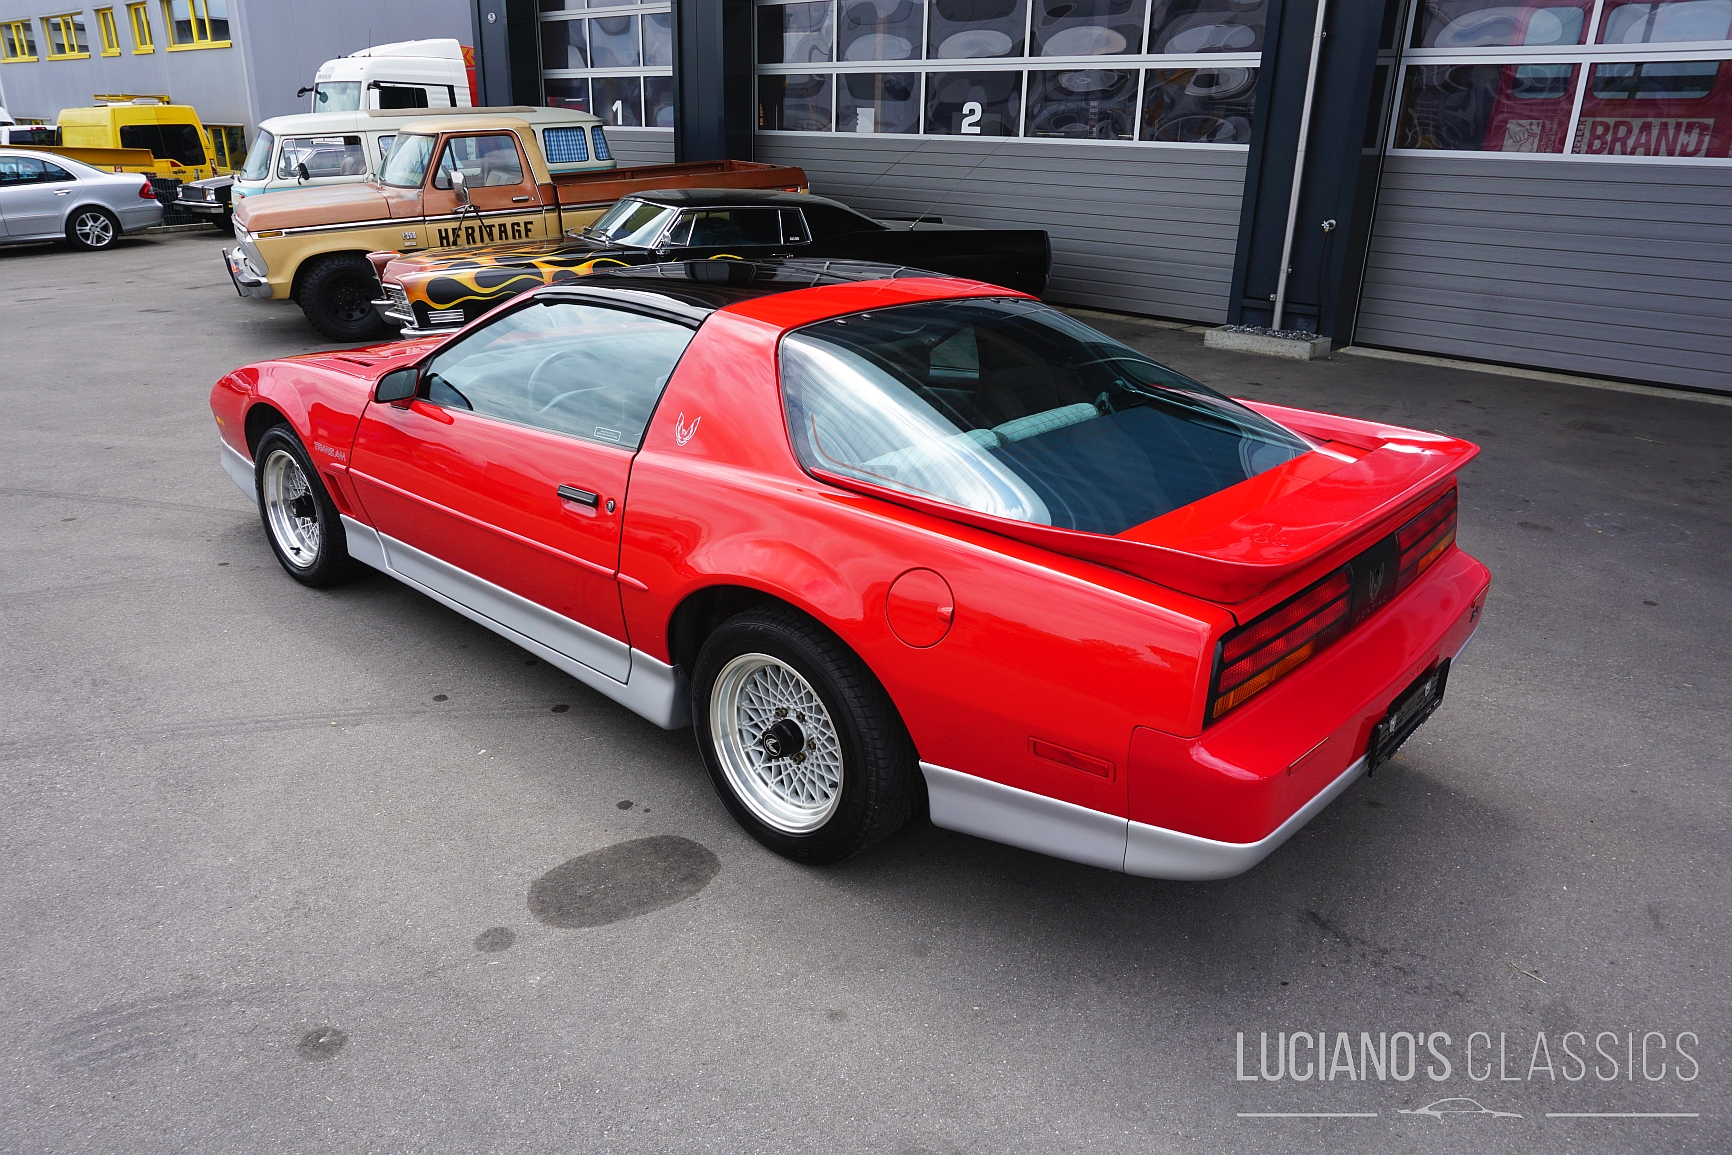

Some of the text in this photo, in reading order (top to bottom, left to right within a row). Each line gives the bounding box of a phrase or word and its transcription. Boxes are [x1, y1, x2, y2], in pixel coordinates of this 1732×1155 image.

[612, 100, 622, 125] 1
[961, 101, 982, 134] 2
[1587, 120, 1712, 157] BRAND
[438, 221, 533, 247] HERITAGE
